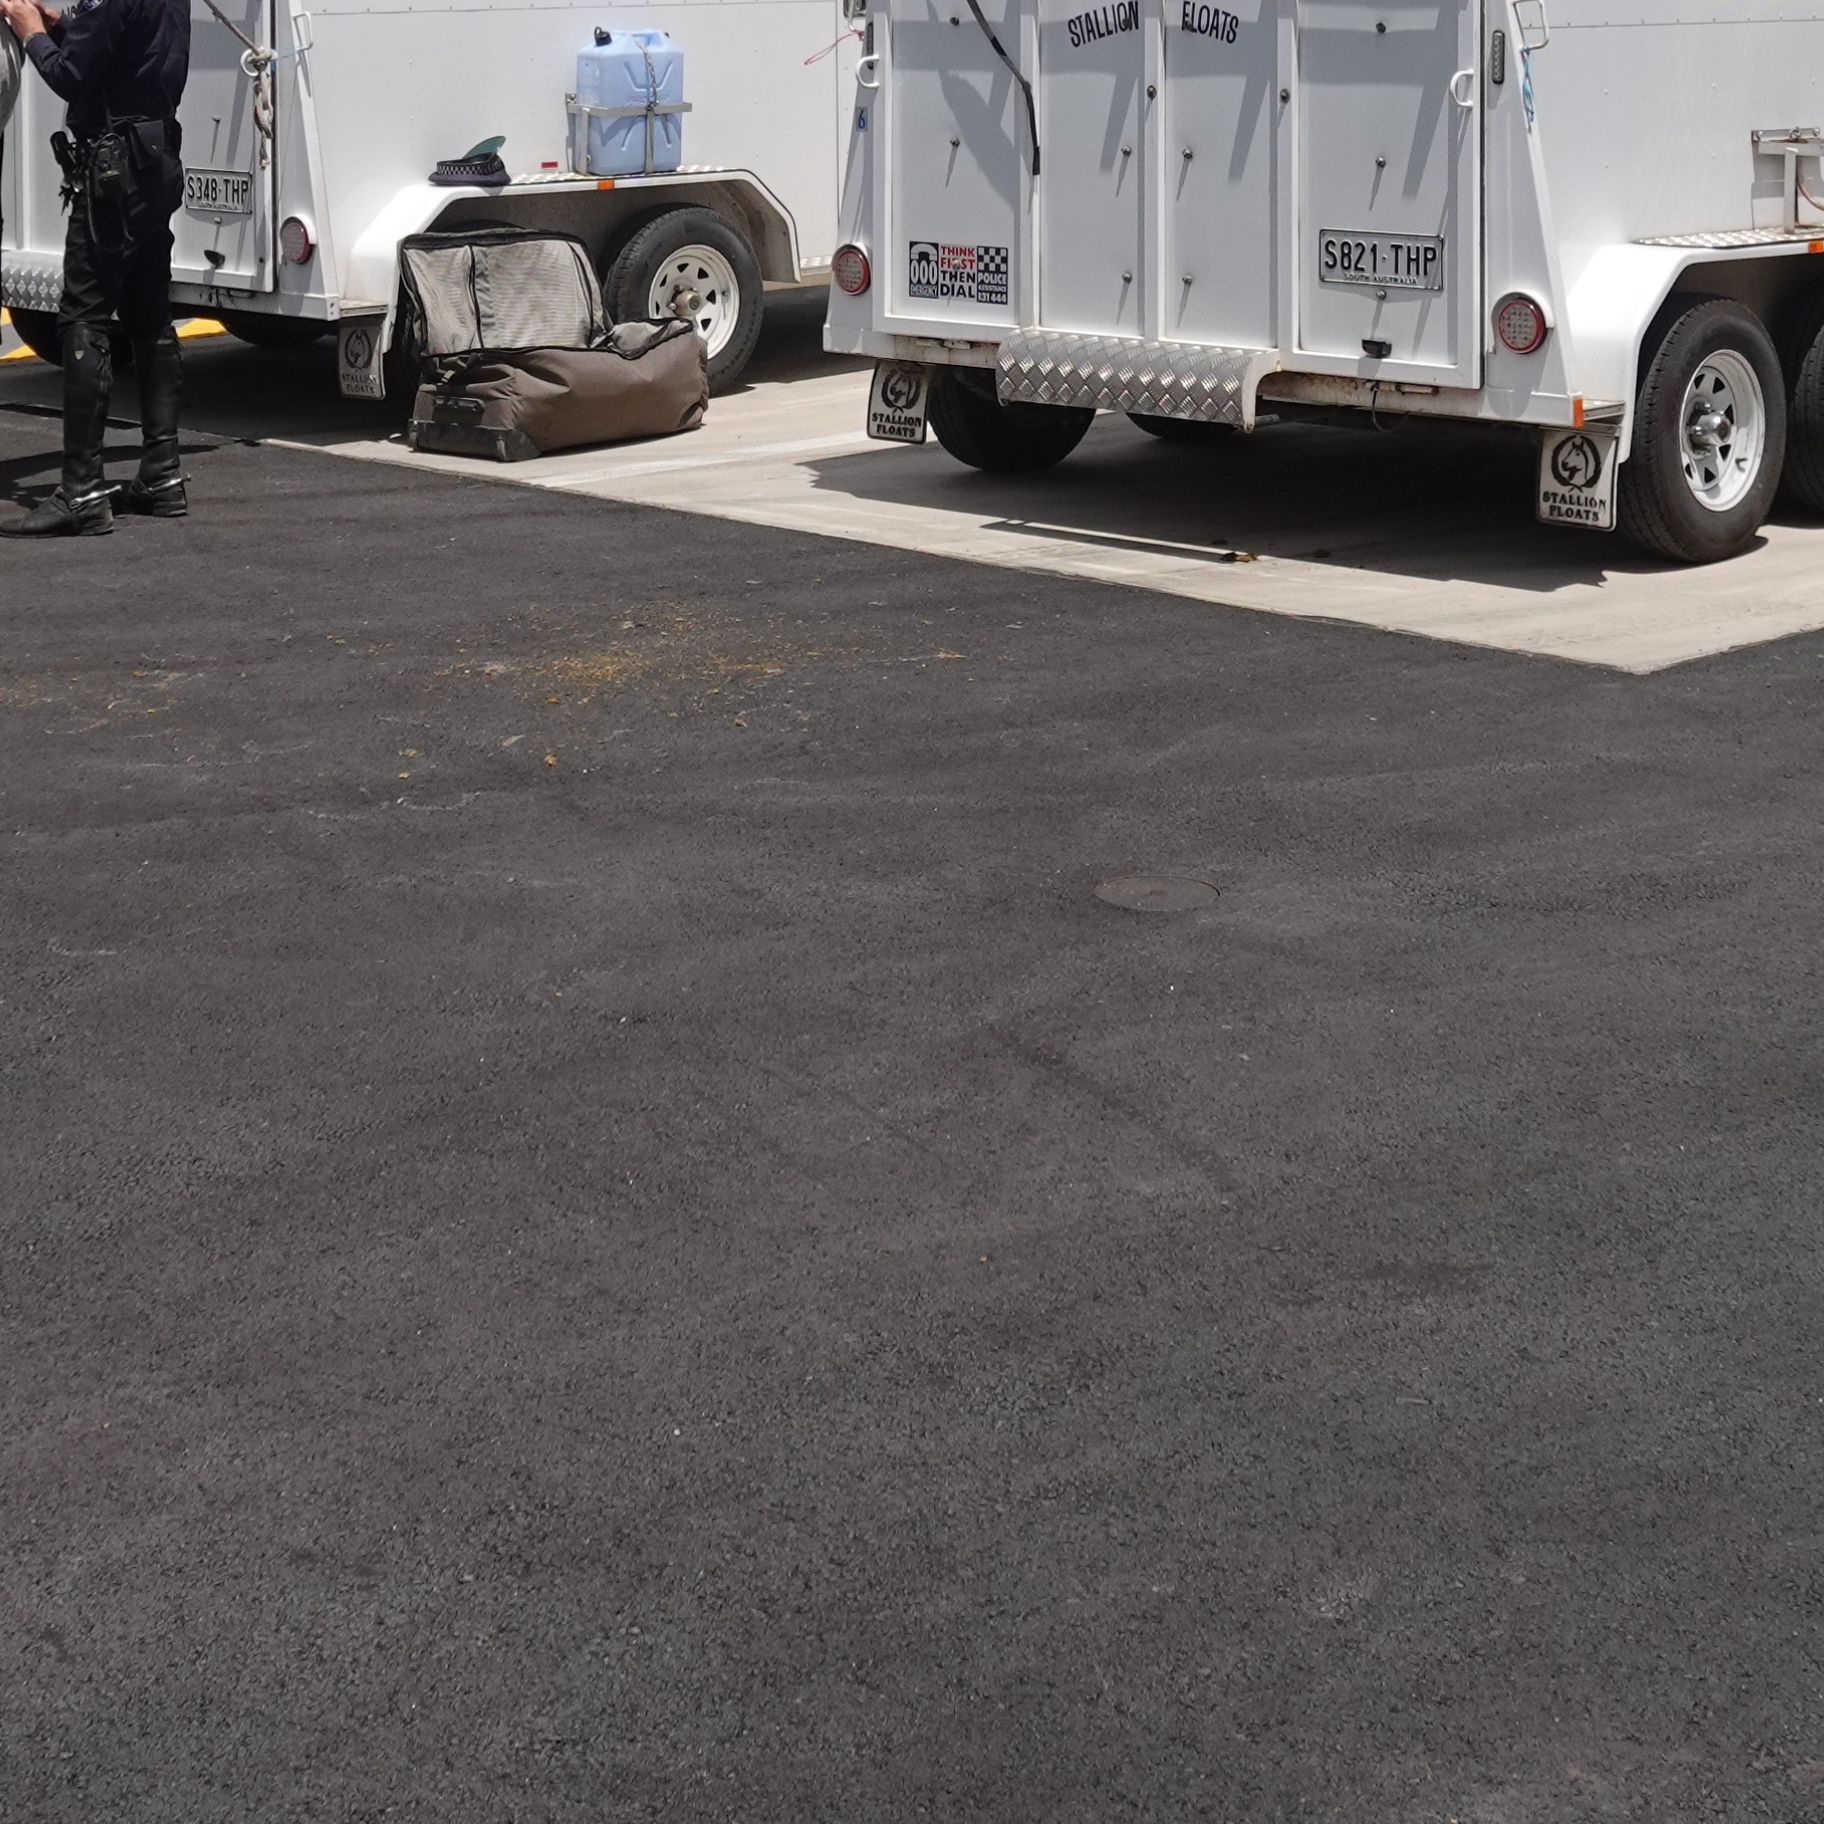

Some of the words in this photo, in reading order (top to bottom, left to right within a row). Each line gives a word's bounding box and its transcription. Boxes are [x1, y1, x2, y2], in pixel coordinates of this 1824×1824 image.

[1068, 0, 1139, 47] STALLION
[1182, 0, 1238, 44] FLOATS
[859, 108, 865, 129] 6
[941, 246, 975, 257] THINK
[911, 259, 937, 285] 000
[940, 270, 975, 283] THEN
[978, 273, 1007, 284] POLICE
[940, 284, 975, 298] DIAL
[978, 292, 989, 302] 131
[872, 412, 922, 427] STALLION
[877, 424, 916, 438] FLOATS
[1542, 491, 1607, 510] STALLION
[1549, 505, 1600, 522] FLOATS
